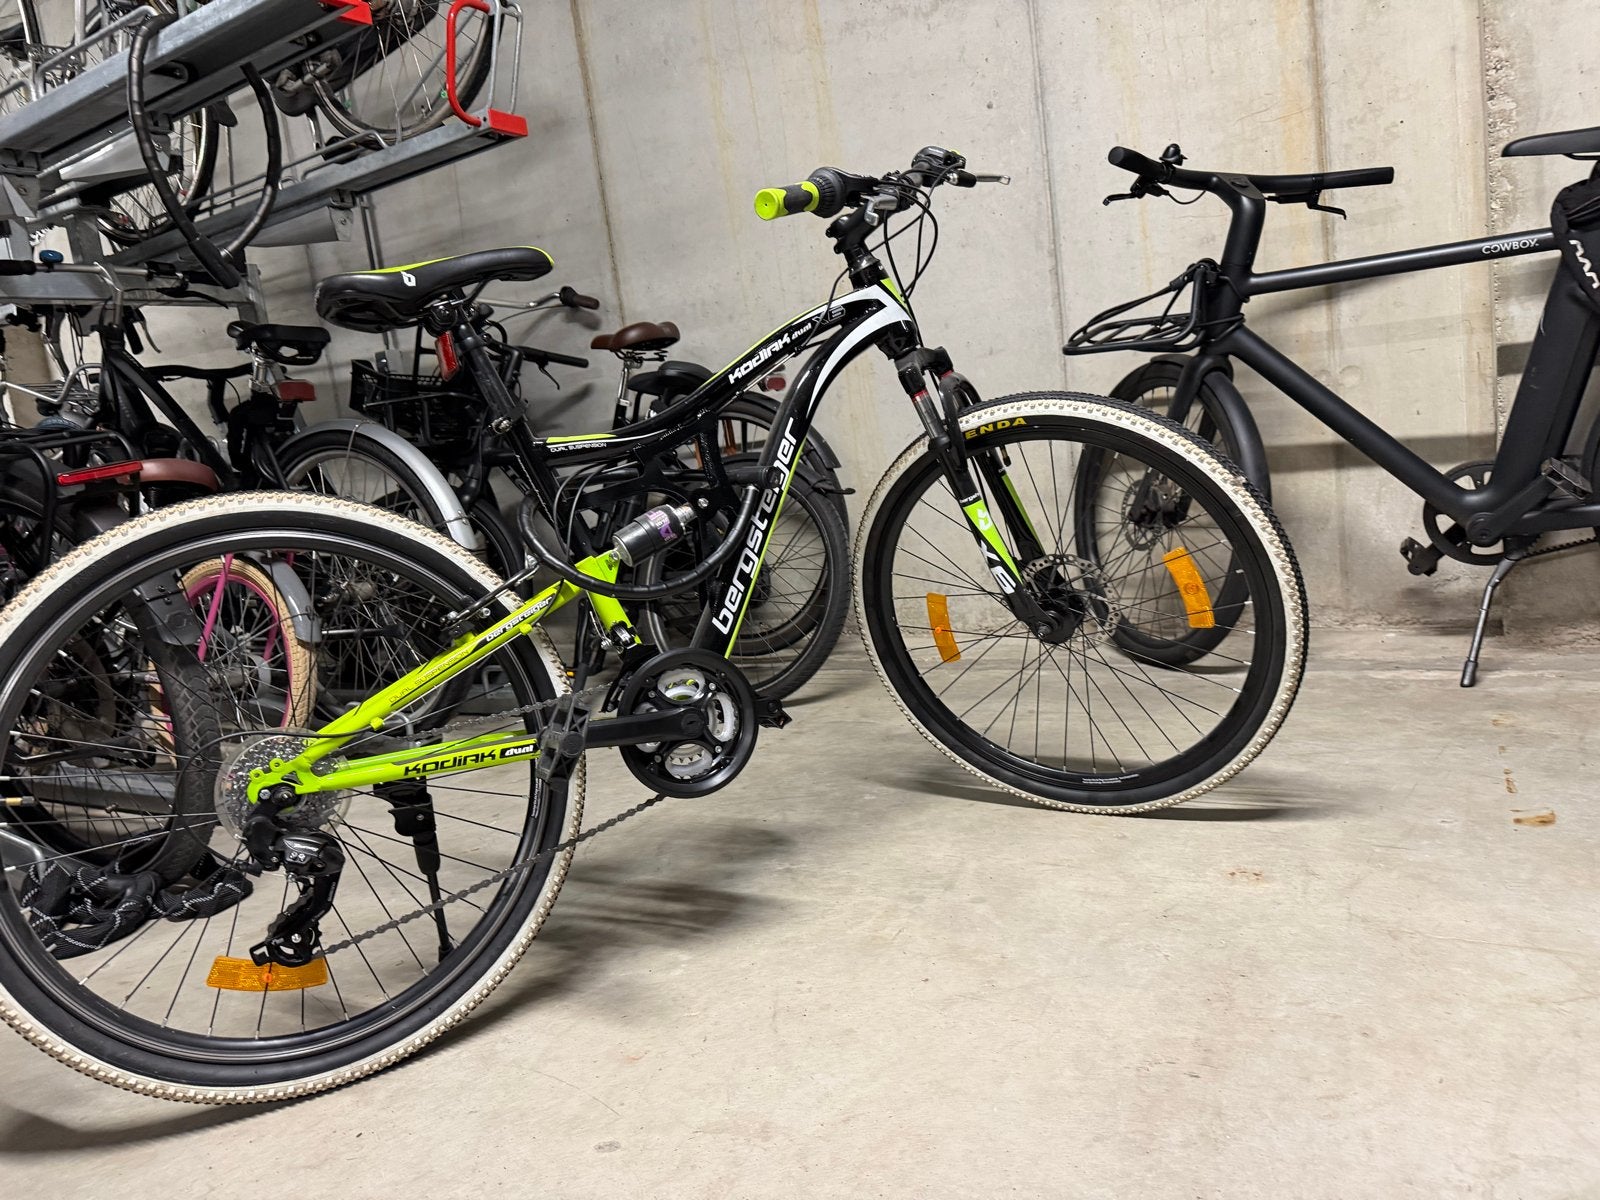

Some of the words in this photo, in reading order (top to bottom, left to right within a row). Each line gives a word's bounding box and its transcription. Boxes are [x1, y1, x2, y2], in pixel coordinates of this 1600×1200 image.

[1482, 239, 1539, 254] COWBOY
[964, 417, 1027, 439] ENDA
[712, 417, 797, 635] bergsteger
